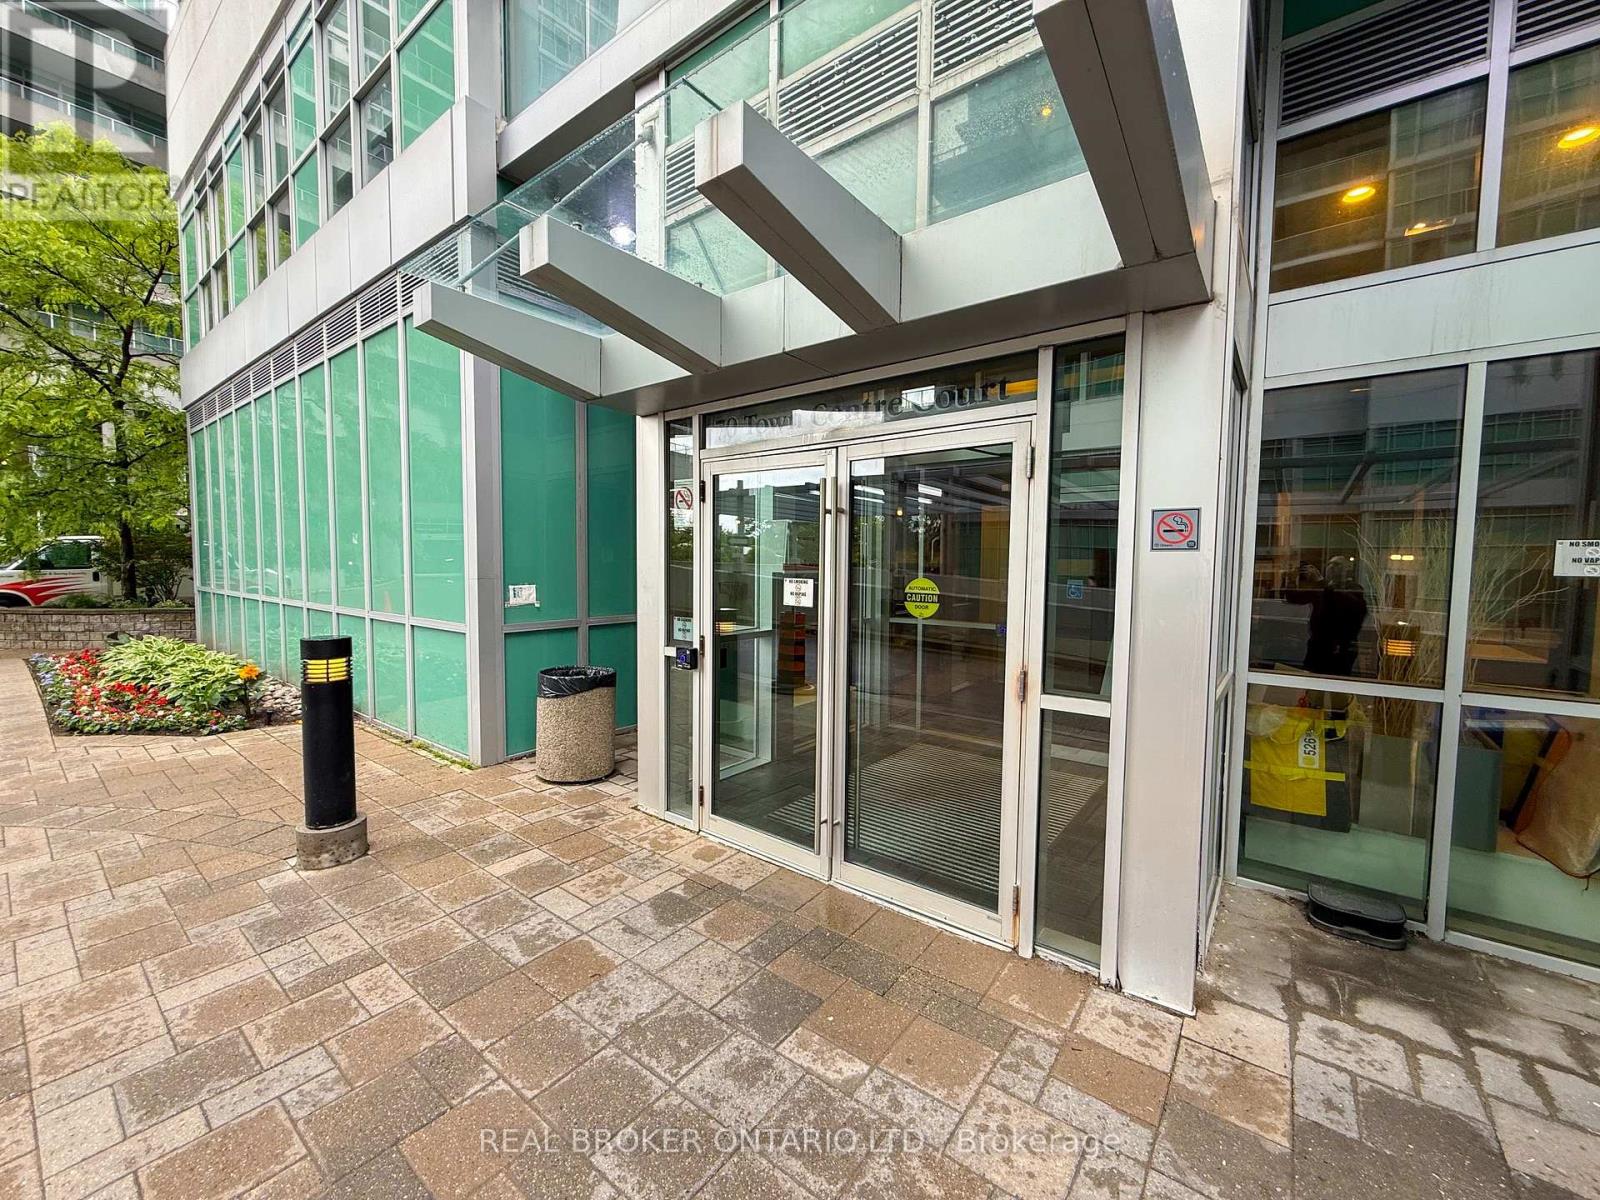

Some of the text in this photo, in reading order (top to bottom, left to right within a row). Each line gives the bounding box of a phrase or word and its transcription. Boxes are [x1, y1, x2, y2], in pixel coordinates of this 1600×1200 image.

[743, 412, 802, 435] Town
[811, 395, 905, 427] Centre
[911, 376, 1012, 412] Court
[906, 593, 938, 602] CAUTION
[1304, 737, 1316, 756] 526
